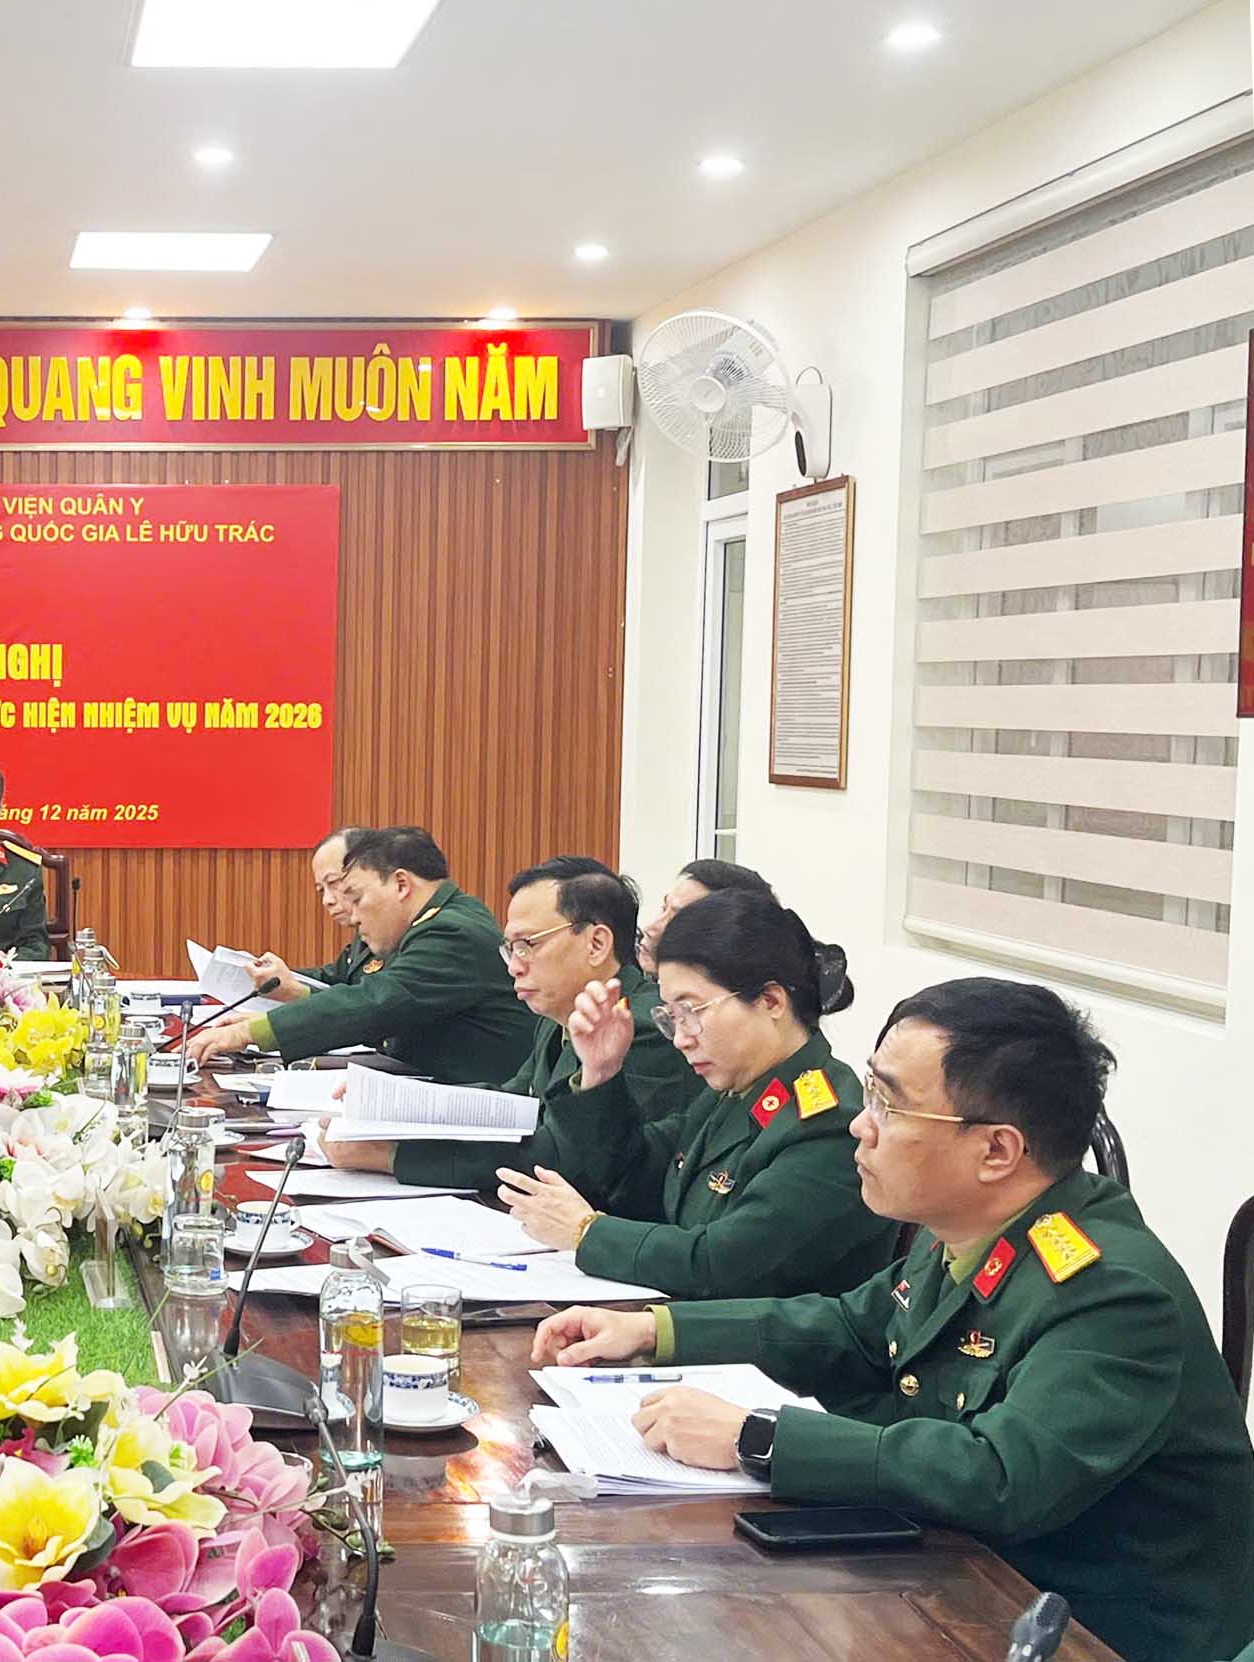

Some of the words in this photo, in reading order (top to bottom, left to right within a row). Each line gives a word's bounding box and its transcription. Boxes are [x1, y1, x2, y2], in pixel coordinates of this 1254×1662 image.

[158, 354, 275, 421] VINH
[289, 342, 432, 422] MUÔN
[444, 343, 558, 421] NĂM
[2, 494, 54, 519] VIỆN
[59, 493, 124, 516] QUÂN
[130, 496, 145, 516] Y
[9, 520, 75, 543] QUỐC
[81, 523, 121, 542] GIA
[125, 519, 154, 543] LÊ
[159, 519, 209, 543] HỮU
[214, 520, 275, 543] TRÁC
[22, 696, 76, 734] HIỆN
[83, 697, 160, 734] NHIỆM
[166, 702, 198, 734] VỤ
[204, 697, 259, 729] NĂM
[264, 702, 323, 729] 2026
[40, 804, 62, 821] 12
[66, 804, 108, 821] năm
[113, 804, 159, 821] 2025
